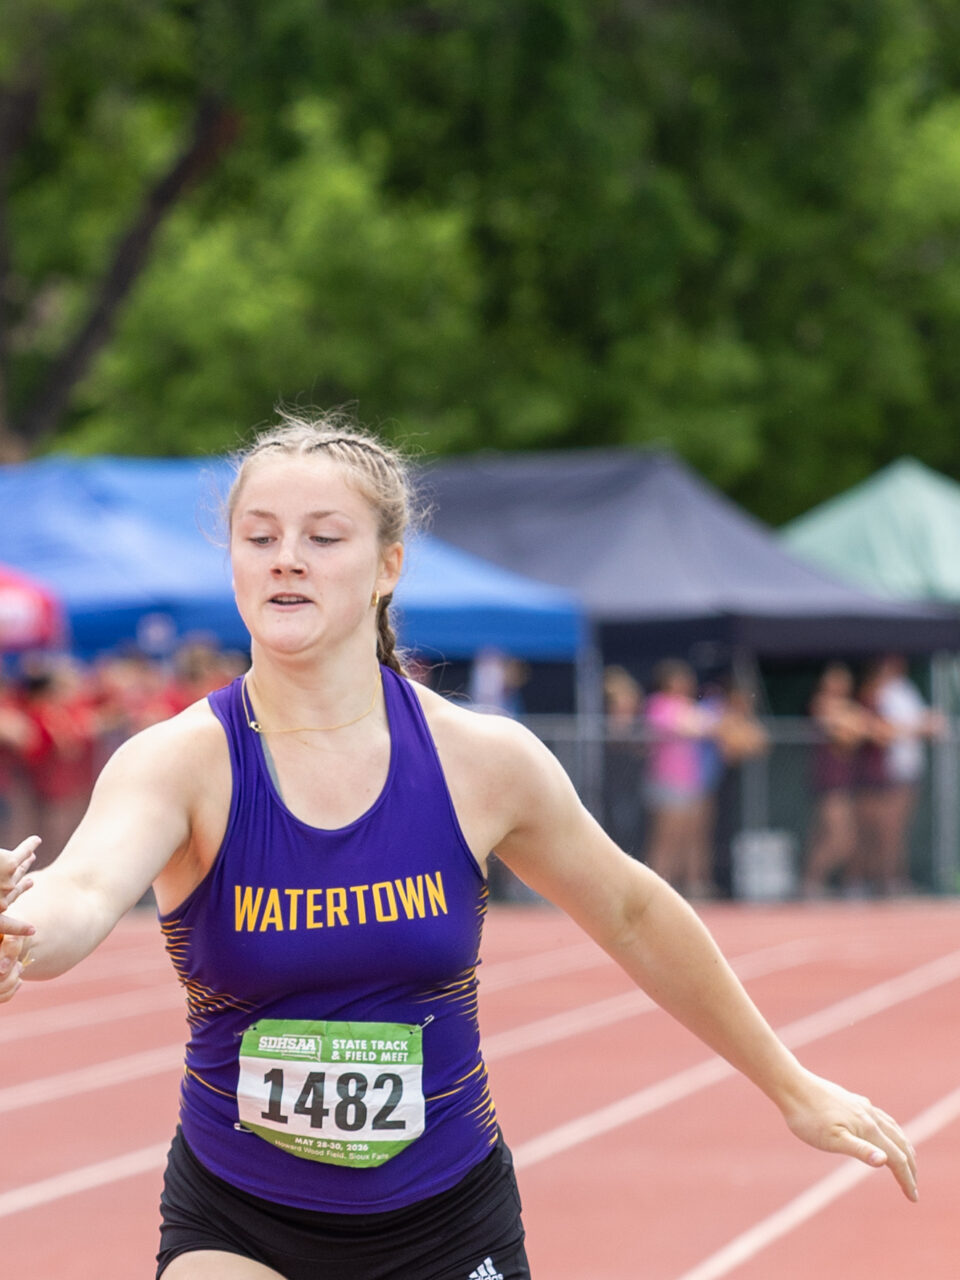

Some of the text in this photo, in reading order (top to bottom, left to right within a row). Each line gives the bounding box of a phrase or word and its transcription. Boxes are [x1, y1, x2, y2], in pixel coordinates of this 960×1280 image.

[234, 871, 448, 932] WATERTOWN
[259, 1036, 316, 1051] SDHSAA
[332, 1039, 408, 1051] STATE TRACK
[331, 1051, 409, 1062] & FIELD MEET
[261, 1068, 406, 1132] 1482
[294, 1137, 314, 1146] MAY
[346, 1143, 369, 1152] 2026
